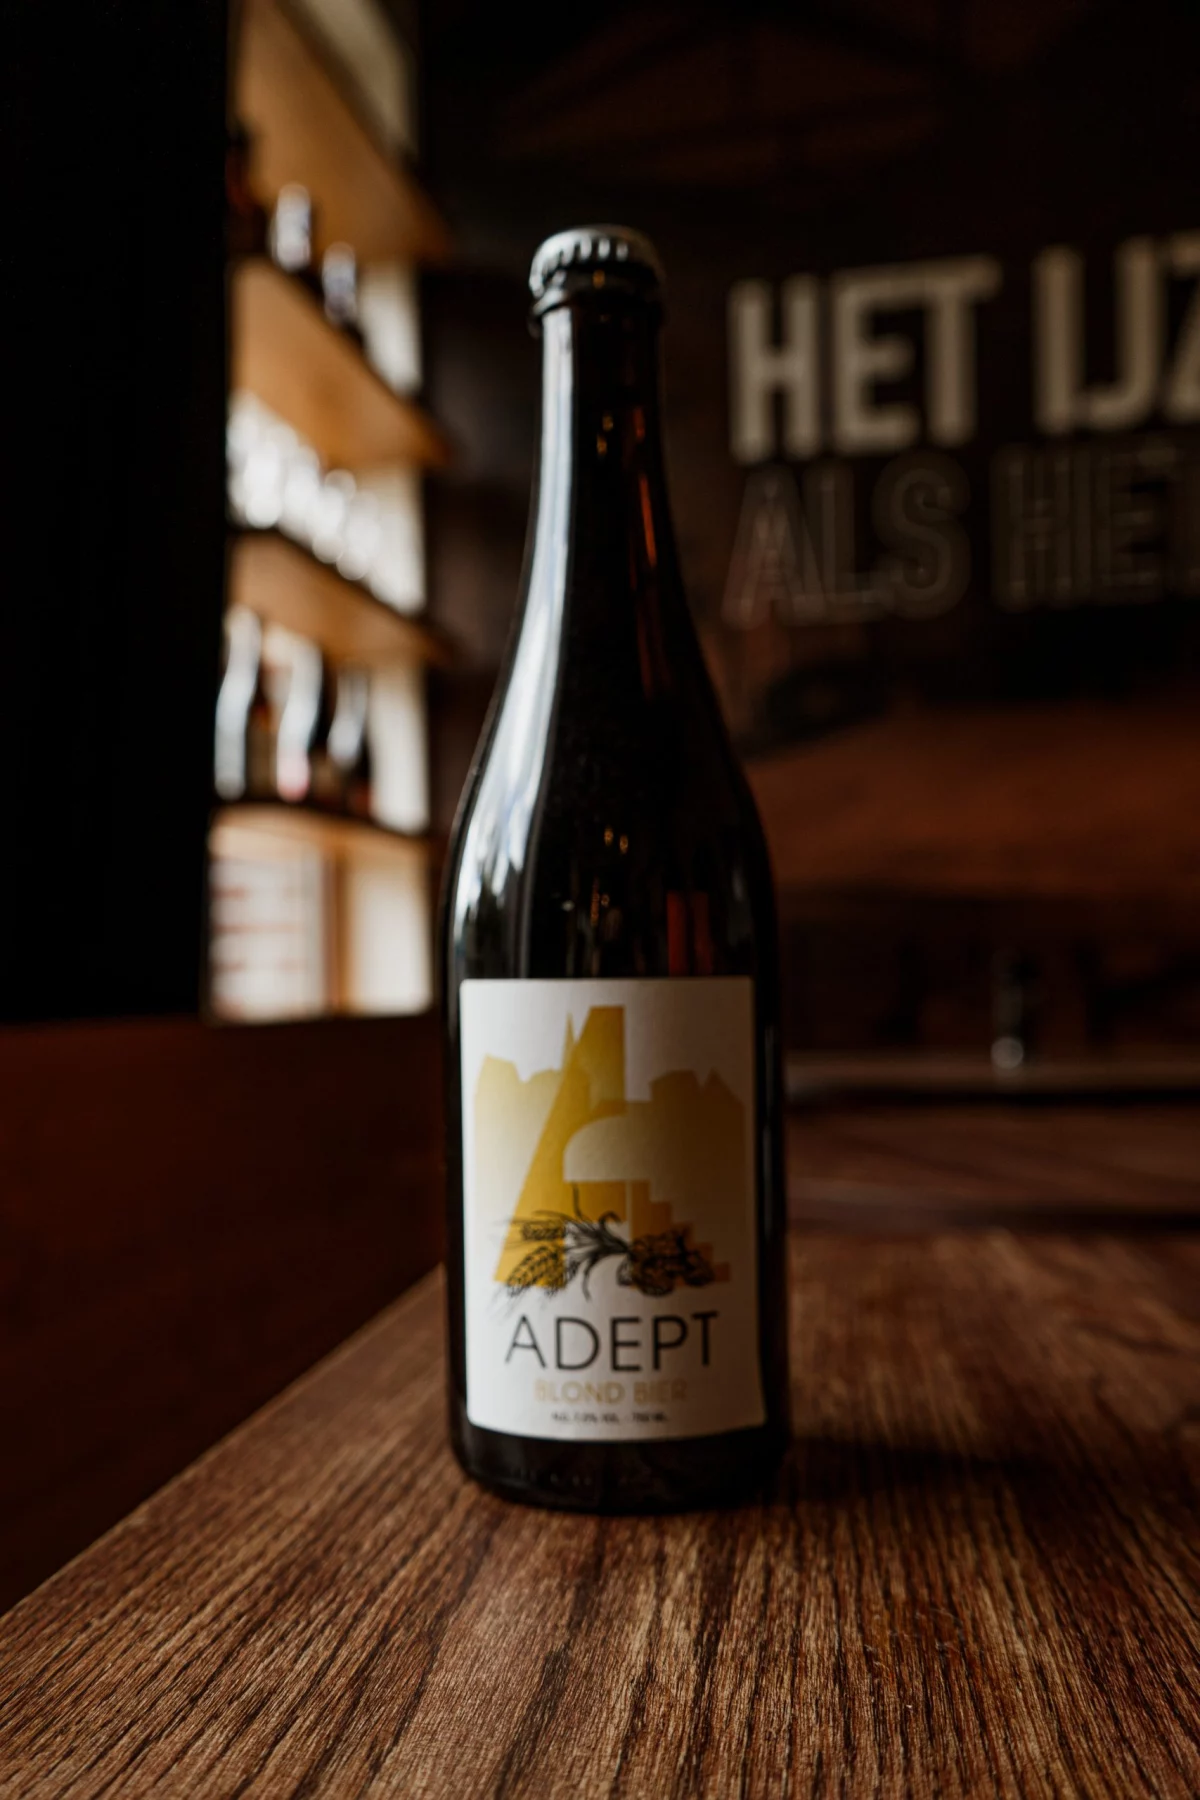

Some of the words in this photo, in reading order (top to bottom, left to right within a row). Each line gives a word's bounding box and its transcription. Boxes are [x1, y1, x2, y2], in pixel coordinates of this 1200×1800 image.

[725, 250, 1003, 467] HET
[721, 448, 973, 631] ALS
[505, 1311, 719, 1372] ADEPT
[533, 1379, 626, 1405] BLOND
[633, 1378, 688, 1405] BIER
